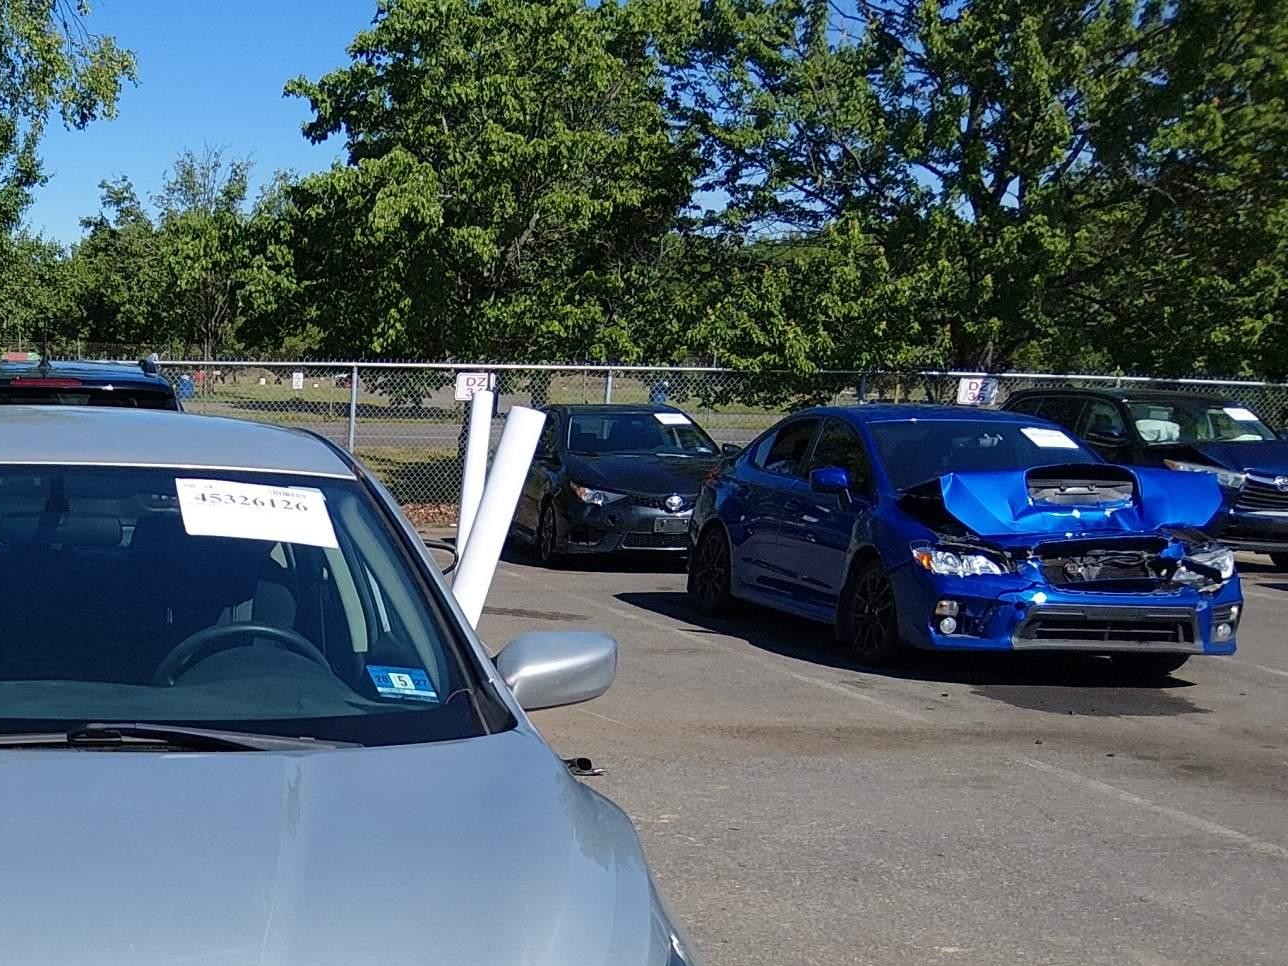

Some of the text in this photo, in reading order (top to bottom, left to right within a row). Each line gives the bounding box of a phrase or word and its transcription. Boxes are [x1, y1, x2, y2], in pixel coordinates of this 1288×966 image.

[466, 377, 487, 387] DZ
[969, 381, 989, 391] DZ
[968, 392, 986, 402] 36
[194, 493, 308, 512] 45326126
[397, 675, 408, 687] 5
